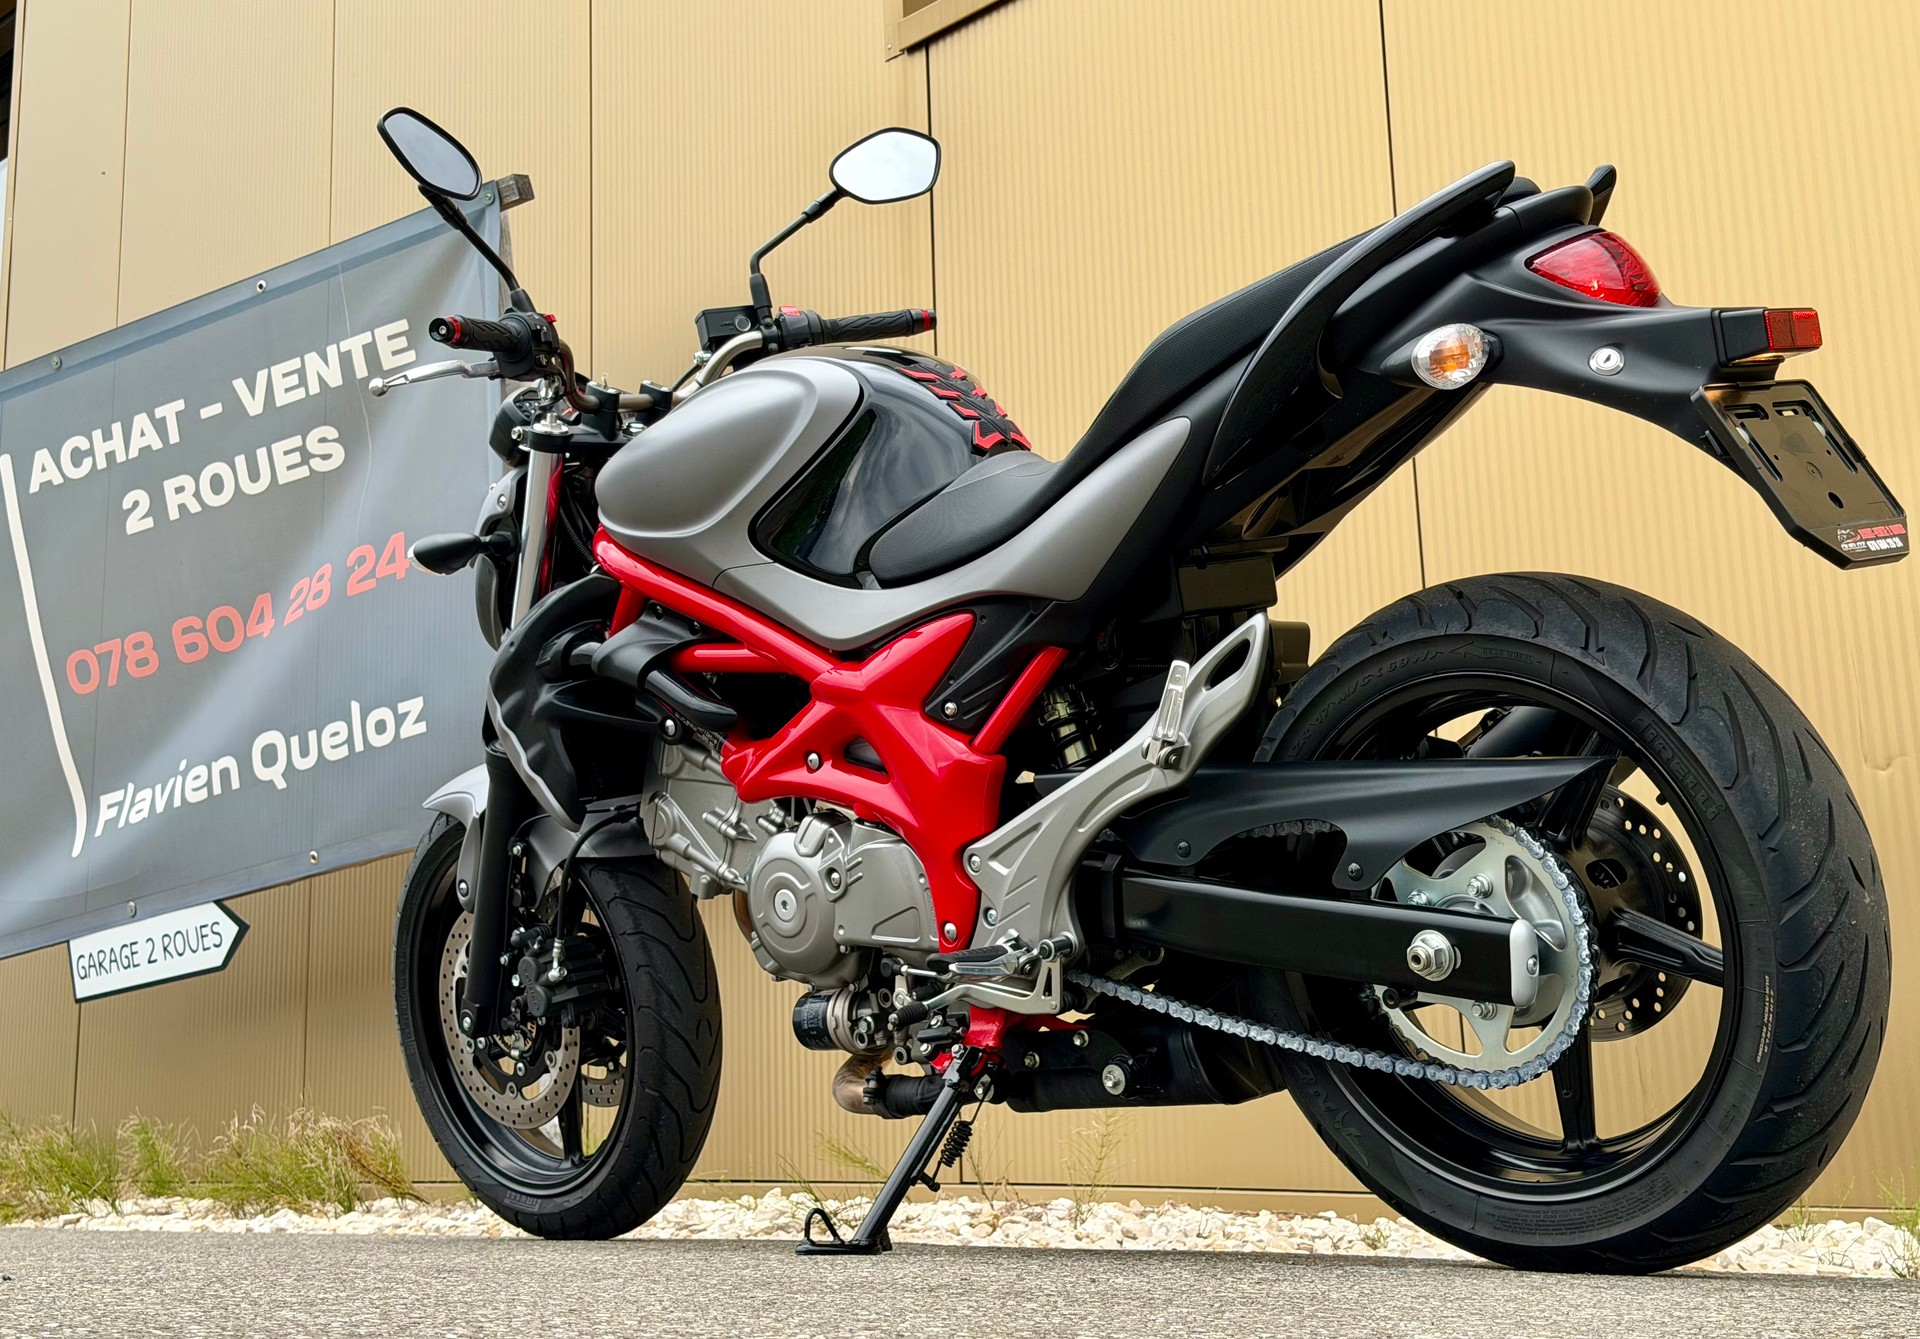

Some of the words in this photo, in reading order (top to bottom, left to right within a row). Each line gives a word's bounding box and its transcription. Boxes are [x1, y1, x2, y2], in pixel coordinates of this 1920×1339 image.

[31, 399, 186, 494] ACHAT
[199, 401, 223, 420] -
[231, 318, 417, 417] VENTE
[122, 488, 155, 536] 2
[162, 425, 346, 522] ROUES
[66, 631, 159, 695] 078
[172, 593, 275, 663] 604
[285, 565, 333, 625] 28
[347, 532, 410, 596] 24
[95, 755, 241, 837] Flavien
[252, 696, 427, 791] Queloz
[76, 940, 141, 981] GARAGE
[145, 936, 158, 965] 2
[161, 921, 223, 962] ROUES
